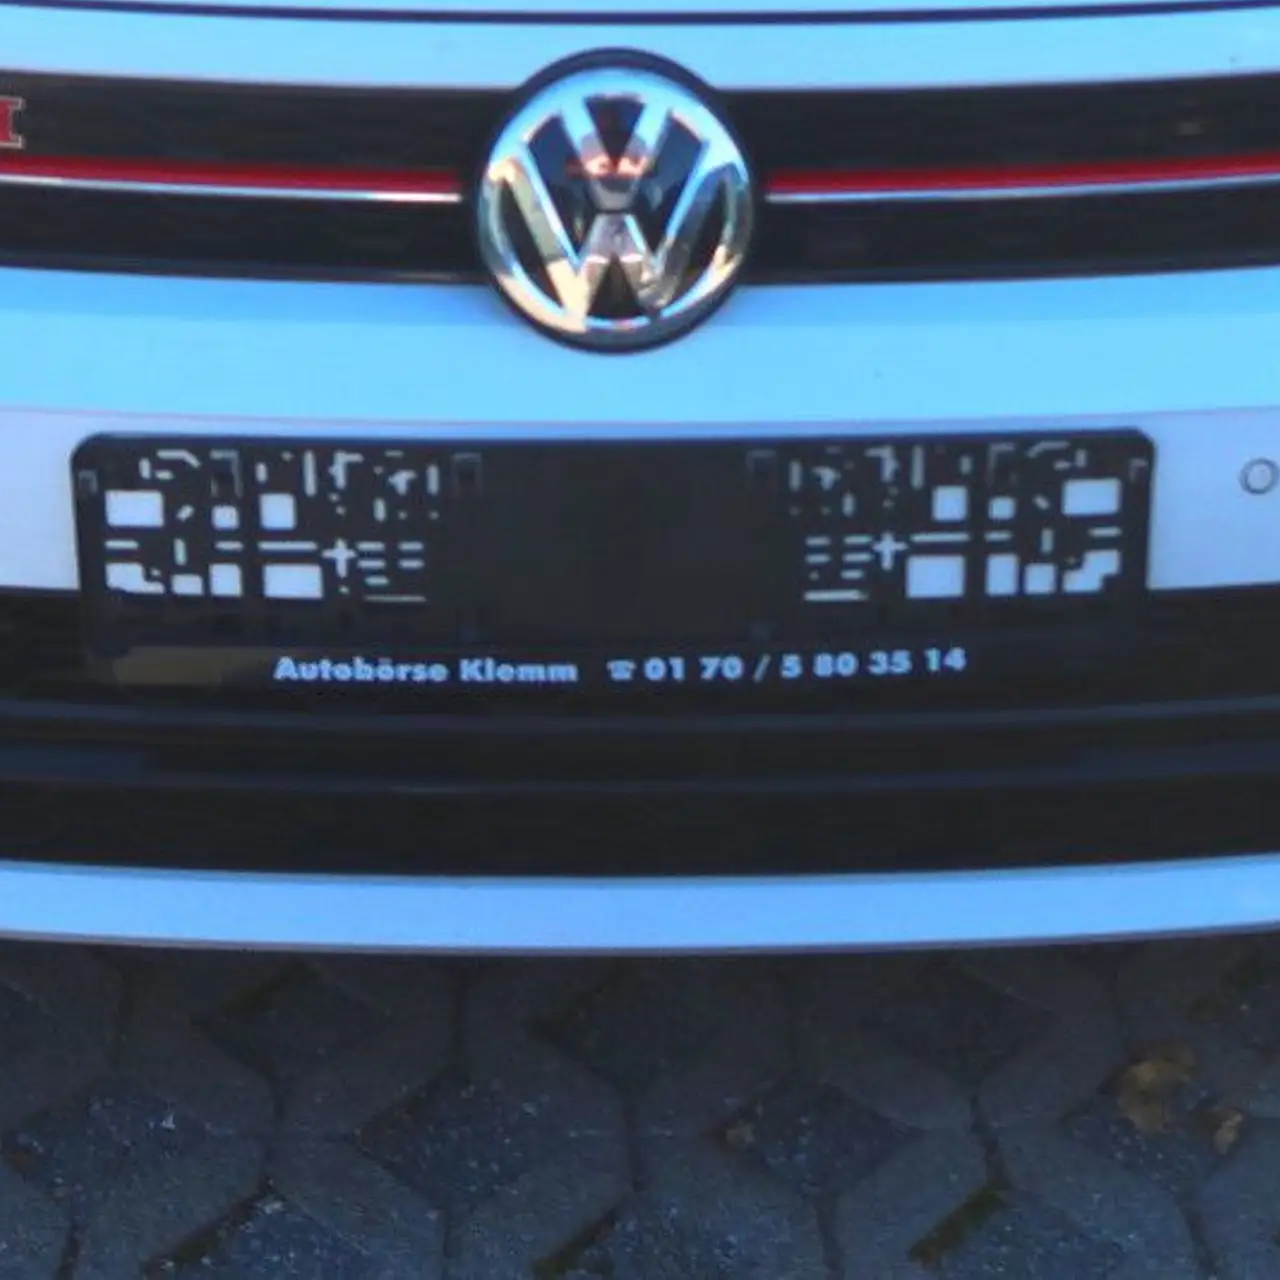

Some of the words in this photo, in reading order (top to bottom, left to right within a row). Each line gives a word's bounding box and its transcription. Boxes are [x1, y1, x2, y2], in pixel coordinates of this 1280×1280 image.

[477, 69, 752, 333] VW
[273, 656, 449, 682] Autobörse
[459, 658, 579, 683] Klemm
[643, 656, 686, 682] 01
[699, 656, 745, 681] 70
[813, 652, 859, 678] 80
[868, 649, 913, 675] 35
[923, 646, 967, 671] 14
